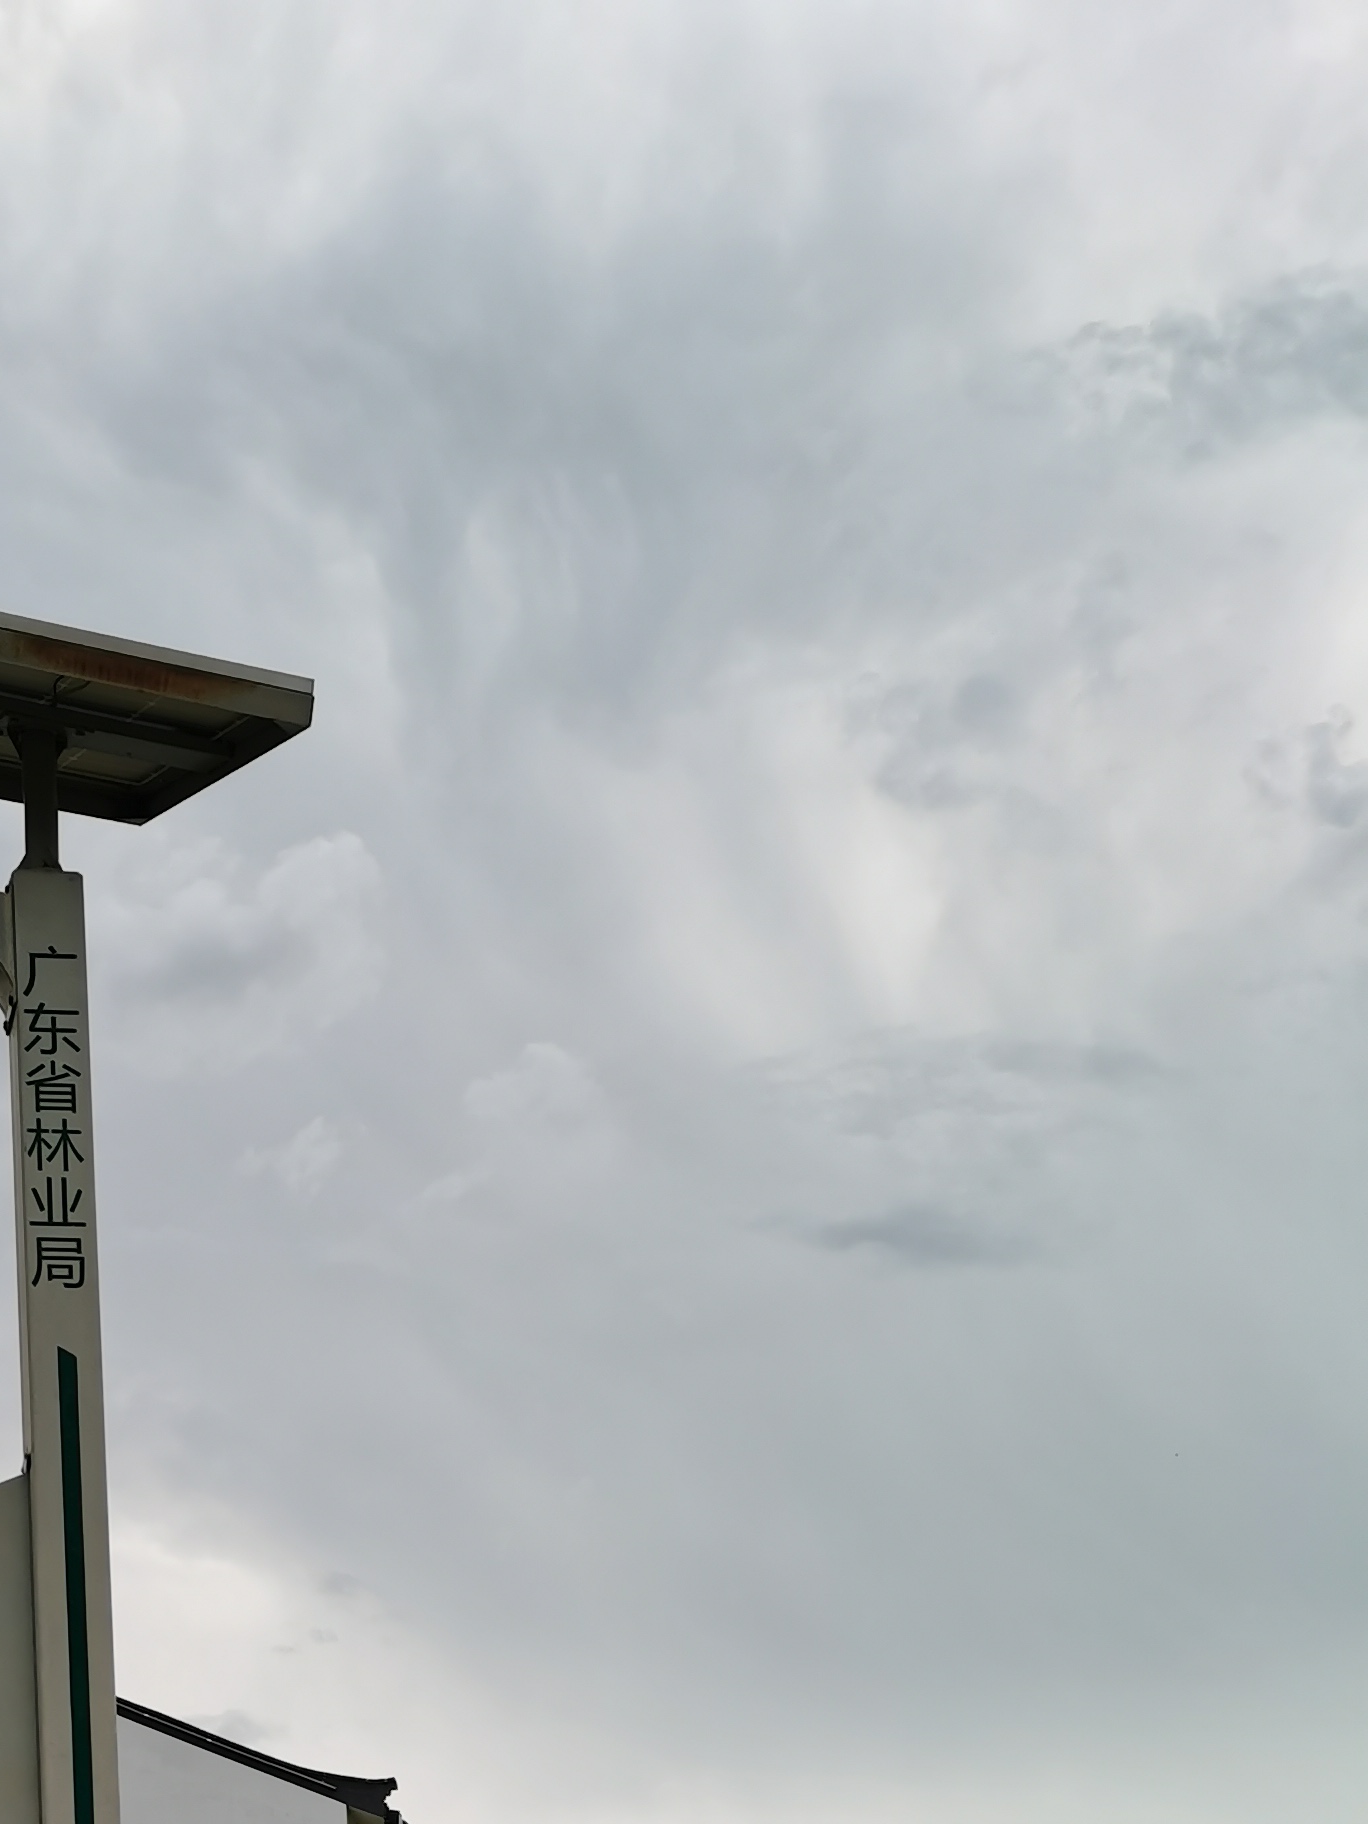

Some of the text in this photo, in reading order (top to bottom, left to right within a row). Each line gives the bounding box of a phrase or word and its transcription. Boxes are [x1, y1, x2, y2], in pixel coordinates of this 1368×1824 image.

[22, 945, 88, 1289] 广东省林业局
